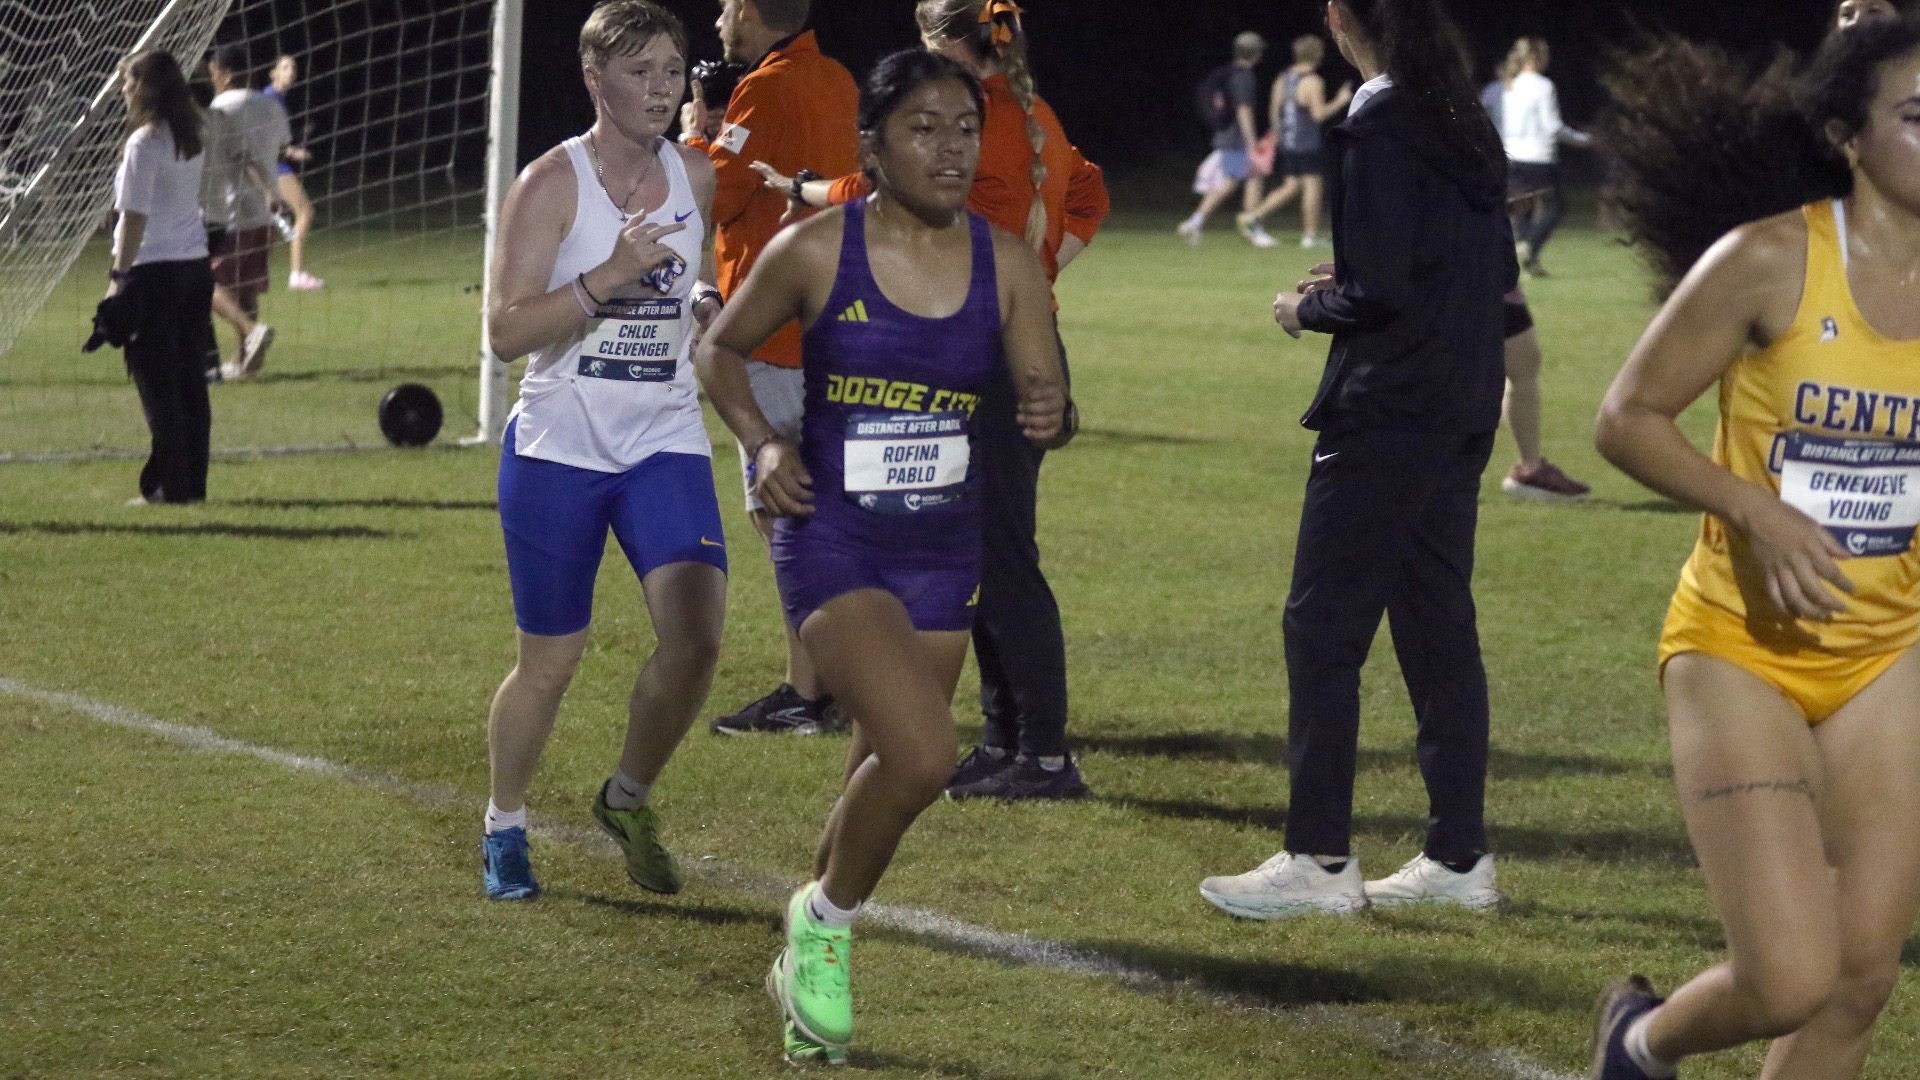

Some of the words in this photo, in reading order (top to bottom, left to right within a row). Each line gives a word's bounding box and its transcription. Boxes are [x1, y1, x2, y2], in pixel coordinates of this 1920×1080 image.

[638, 304, 660, 315] AFTER
[660, 304, 678, 314] DARK
[618, 324, 658, 339] CHLOE
[598, 340, 669, 357] CLEVENGER
[827, 374, 929, 412] DODGE
[857, 422, 906, 435] DISTANCE
[907, 420, 938, 434] AFTER
[938, 419, 961, 432] DARK
[883, 443, 939, 463] ROFINA
[886, 465, 936, 485] PABLO
[1809, 470, 1908, 496] GENEVIEVE
[1828, 498, 1893, 522] YOUNG
